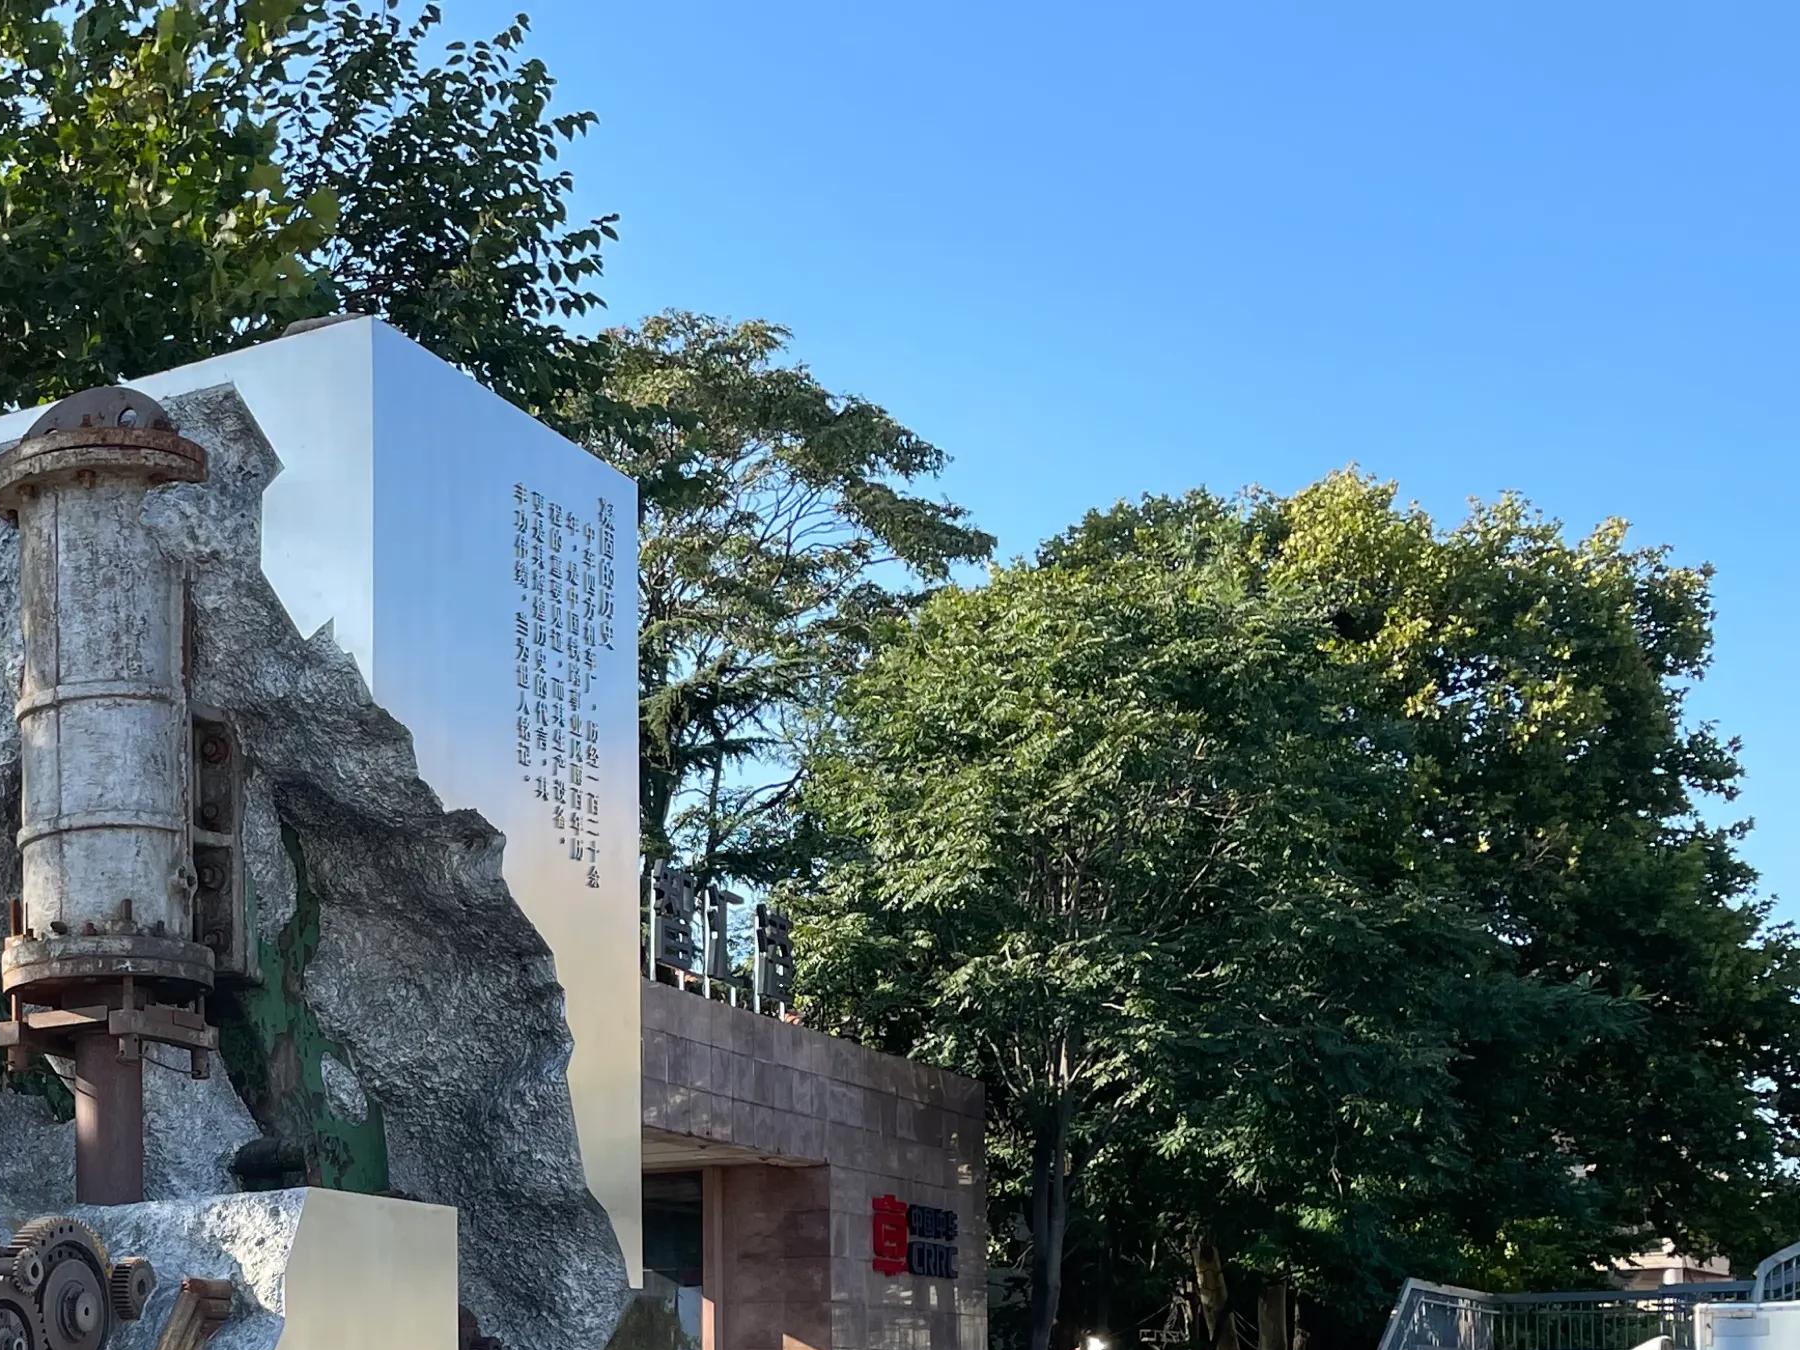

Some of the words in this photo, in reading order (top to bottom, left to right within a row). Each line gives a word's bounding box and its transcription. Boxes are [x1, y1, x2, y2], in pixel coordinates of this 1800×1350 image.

[597, 496, 616, 650] 凝固的历史
[909, 1204, 959, 1241] 中国中车
[909, 1241, 959, 1279] CRRC
